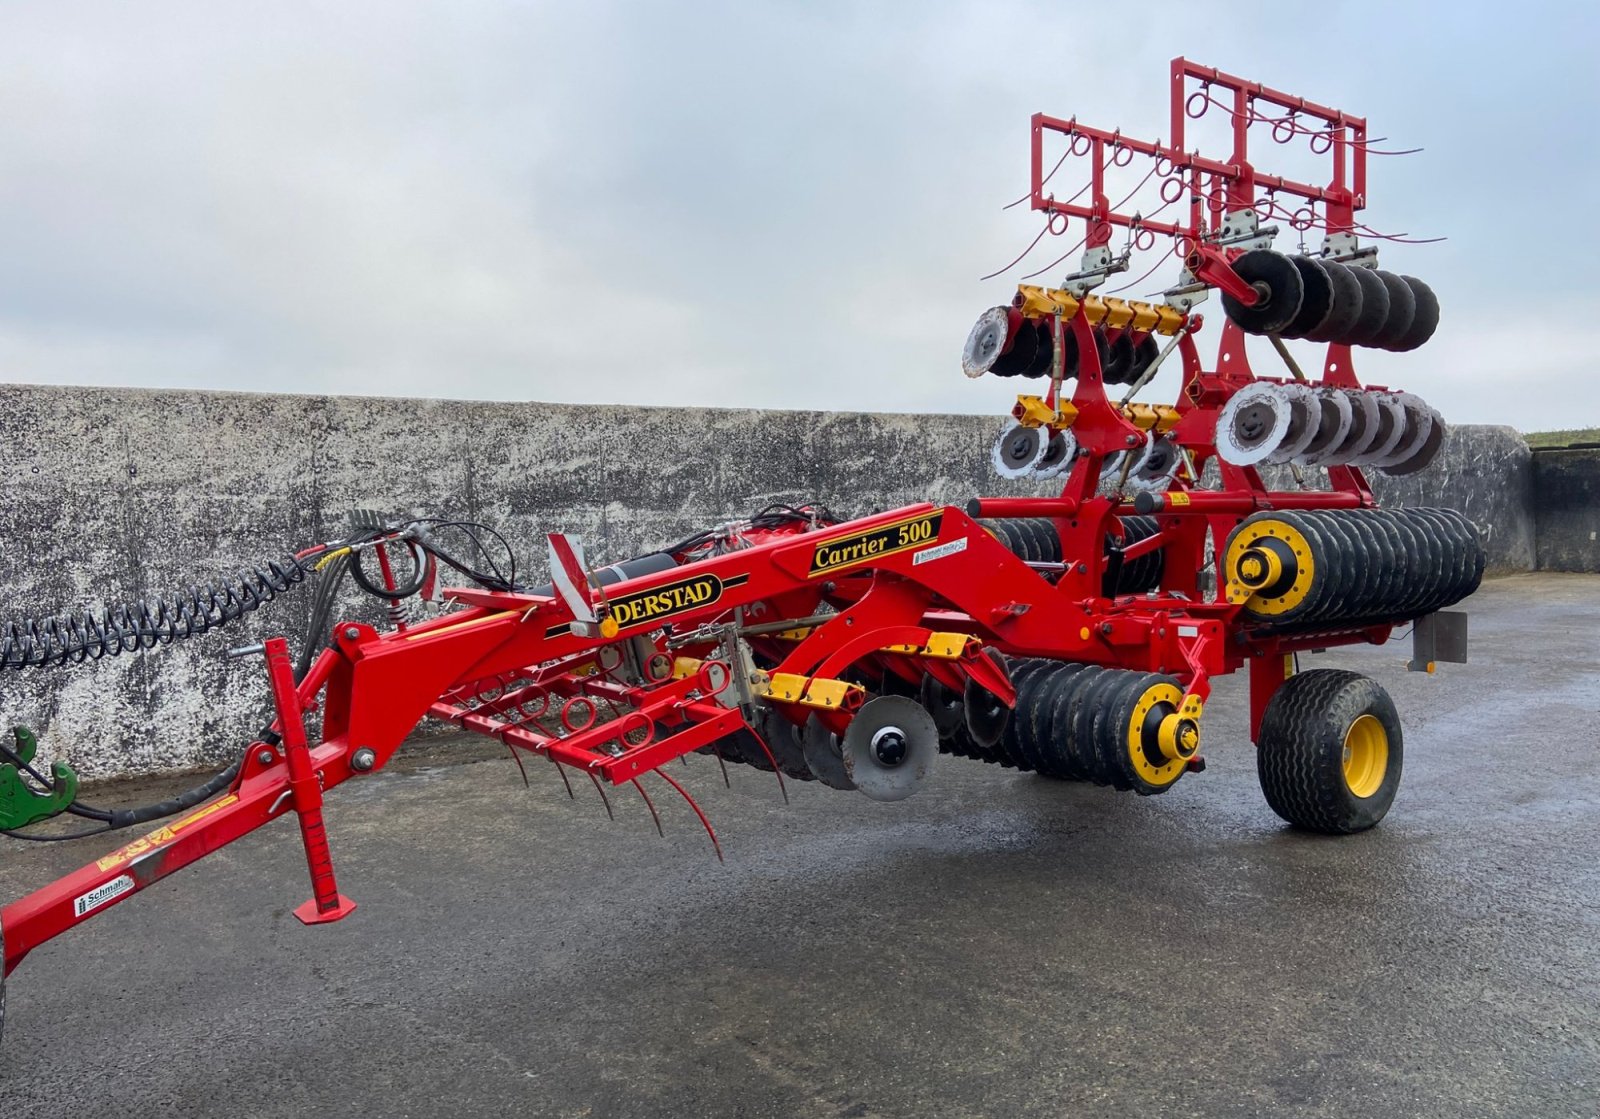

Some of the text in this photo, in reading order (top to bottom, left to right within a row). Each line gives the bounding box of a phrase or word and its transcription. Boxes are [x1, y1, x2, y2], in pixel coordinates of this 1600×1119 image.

[815, 519, 931, 567] Carrier 500
[609, 581, 713, 624] DERSTAD
